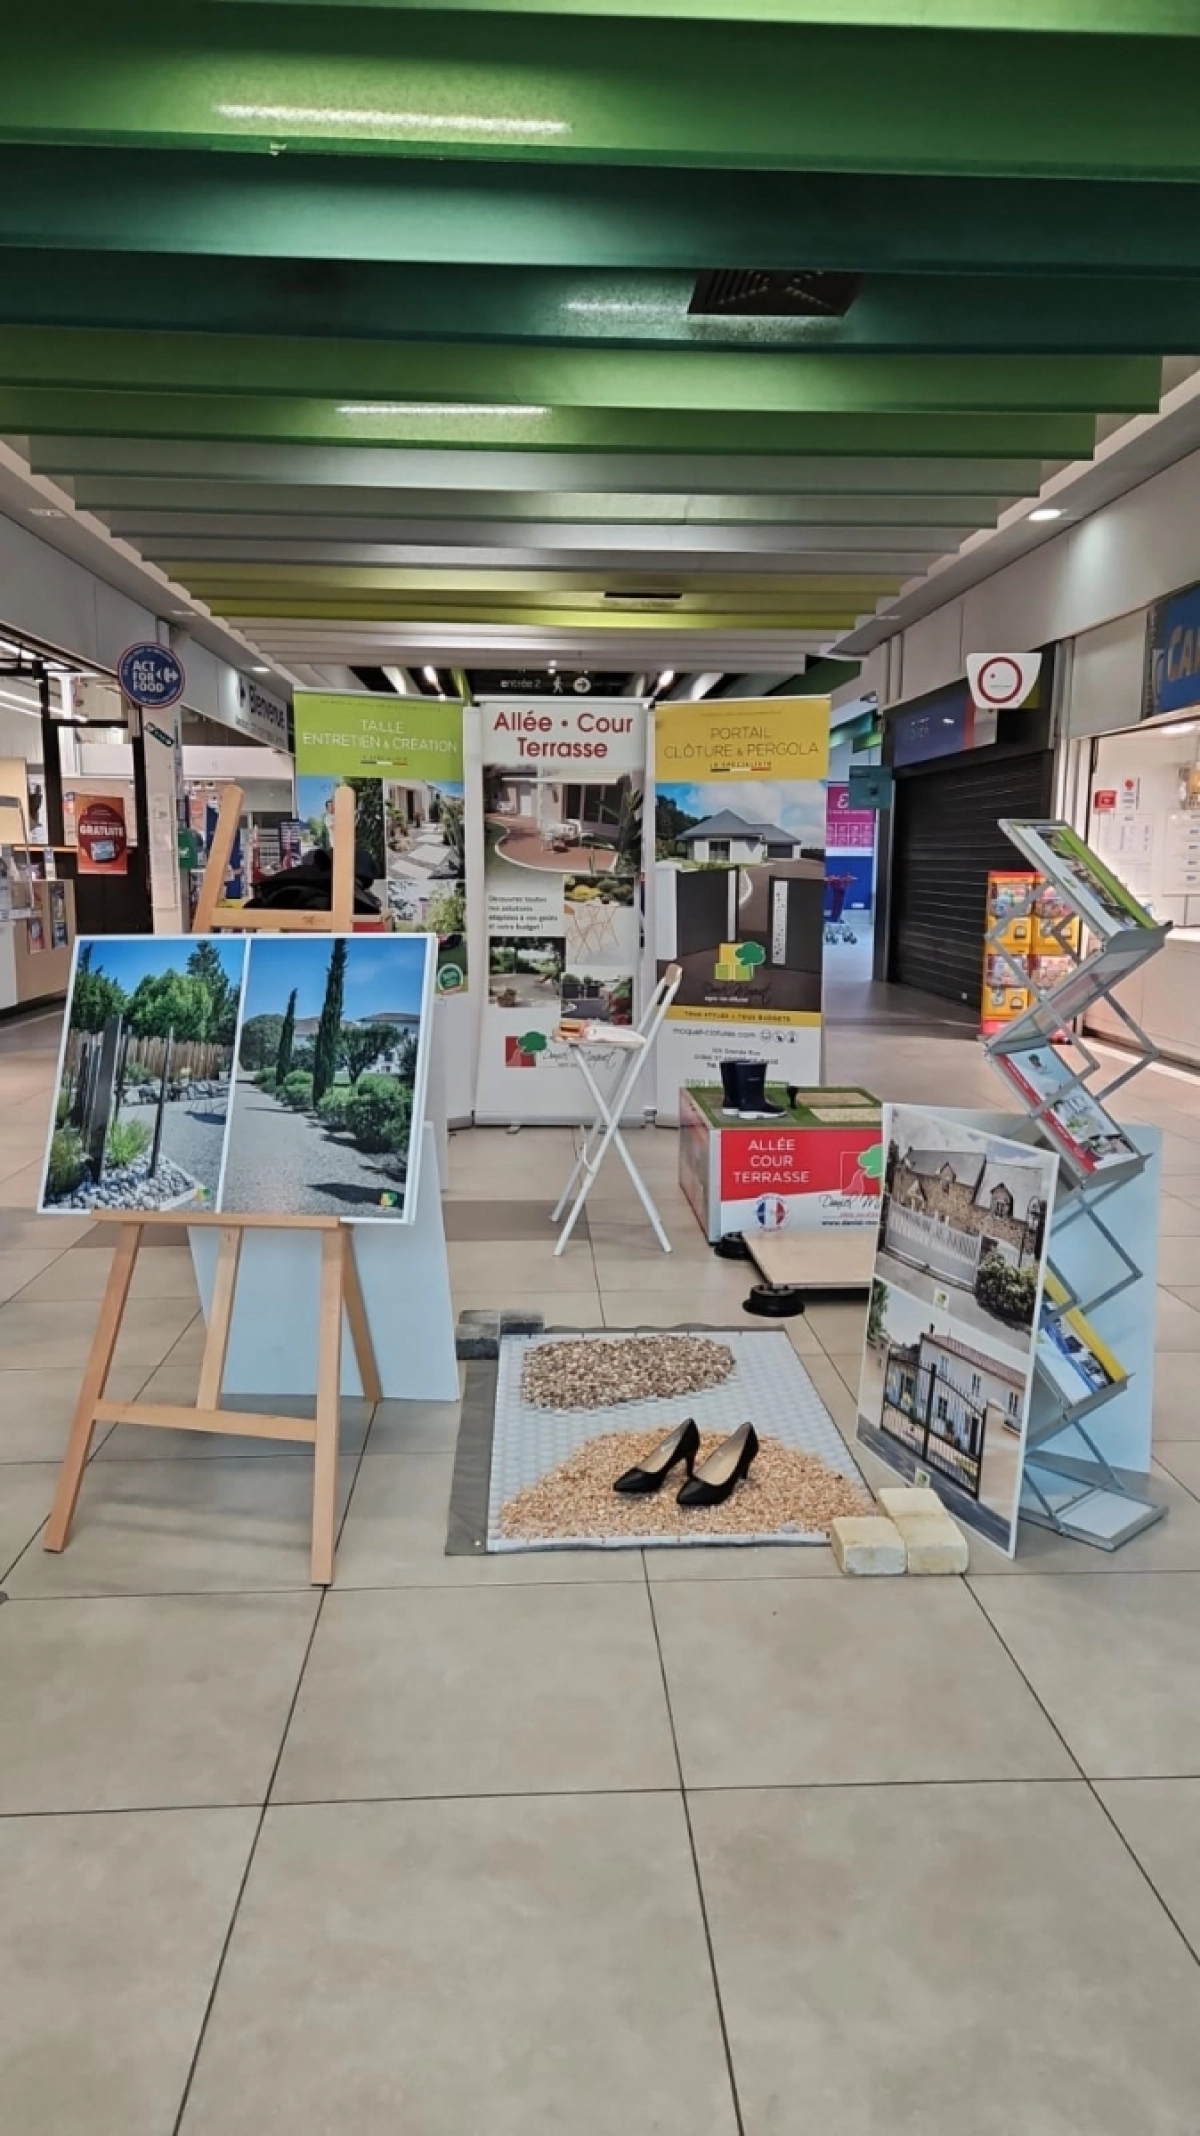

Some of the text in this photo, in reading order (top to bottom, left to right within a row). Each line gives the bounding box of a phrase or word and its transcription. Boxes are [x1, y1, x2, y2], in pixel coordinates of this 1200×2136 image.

[133, 660, 155, 671] ACT
[133, 672, 154, 682] FOR
[133, 682, 164, 692] FOOD
[361, 718, 405, 734] TAILLE
[493, 710, 634, 733] Allée Cour
[710, 725, 772, 741] PORTAIL
[302, 732, 380, 749] ENTRETIEN
[516, 736, 608, 757] Terrasse
[664, 742, 732, 760] CLÔTURE
[747, 741, 820, 757] PERGOLA
[80, 825, 124, 836] GRATUITE
[748, 1137, 796, 1151] ALLÉE
[750, 1155, 793, 1167] COUR
[732, 1171, 810, 1183] TERRASSE
